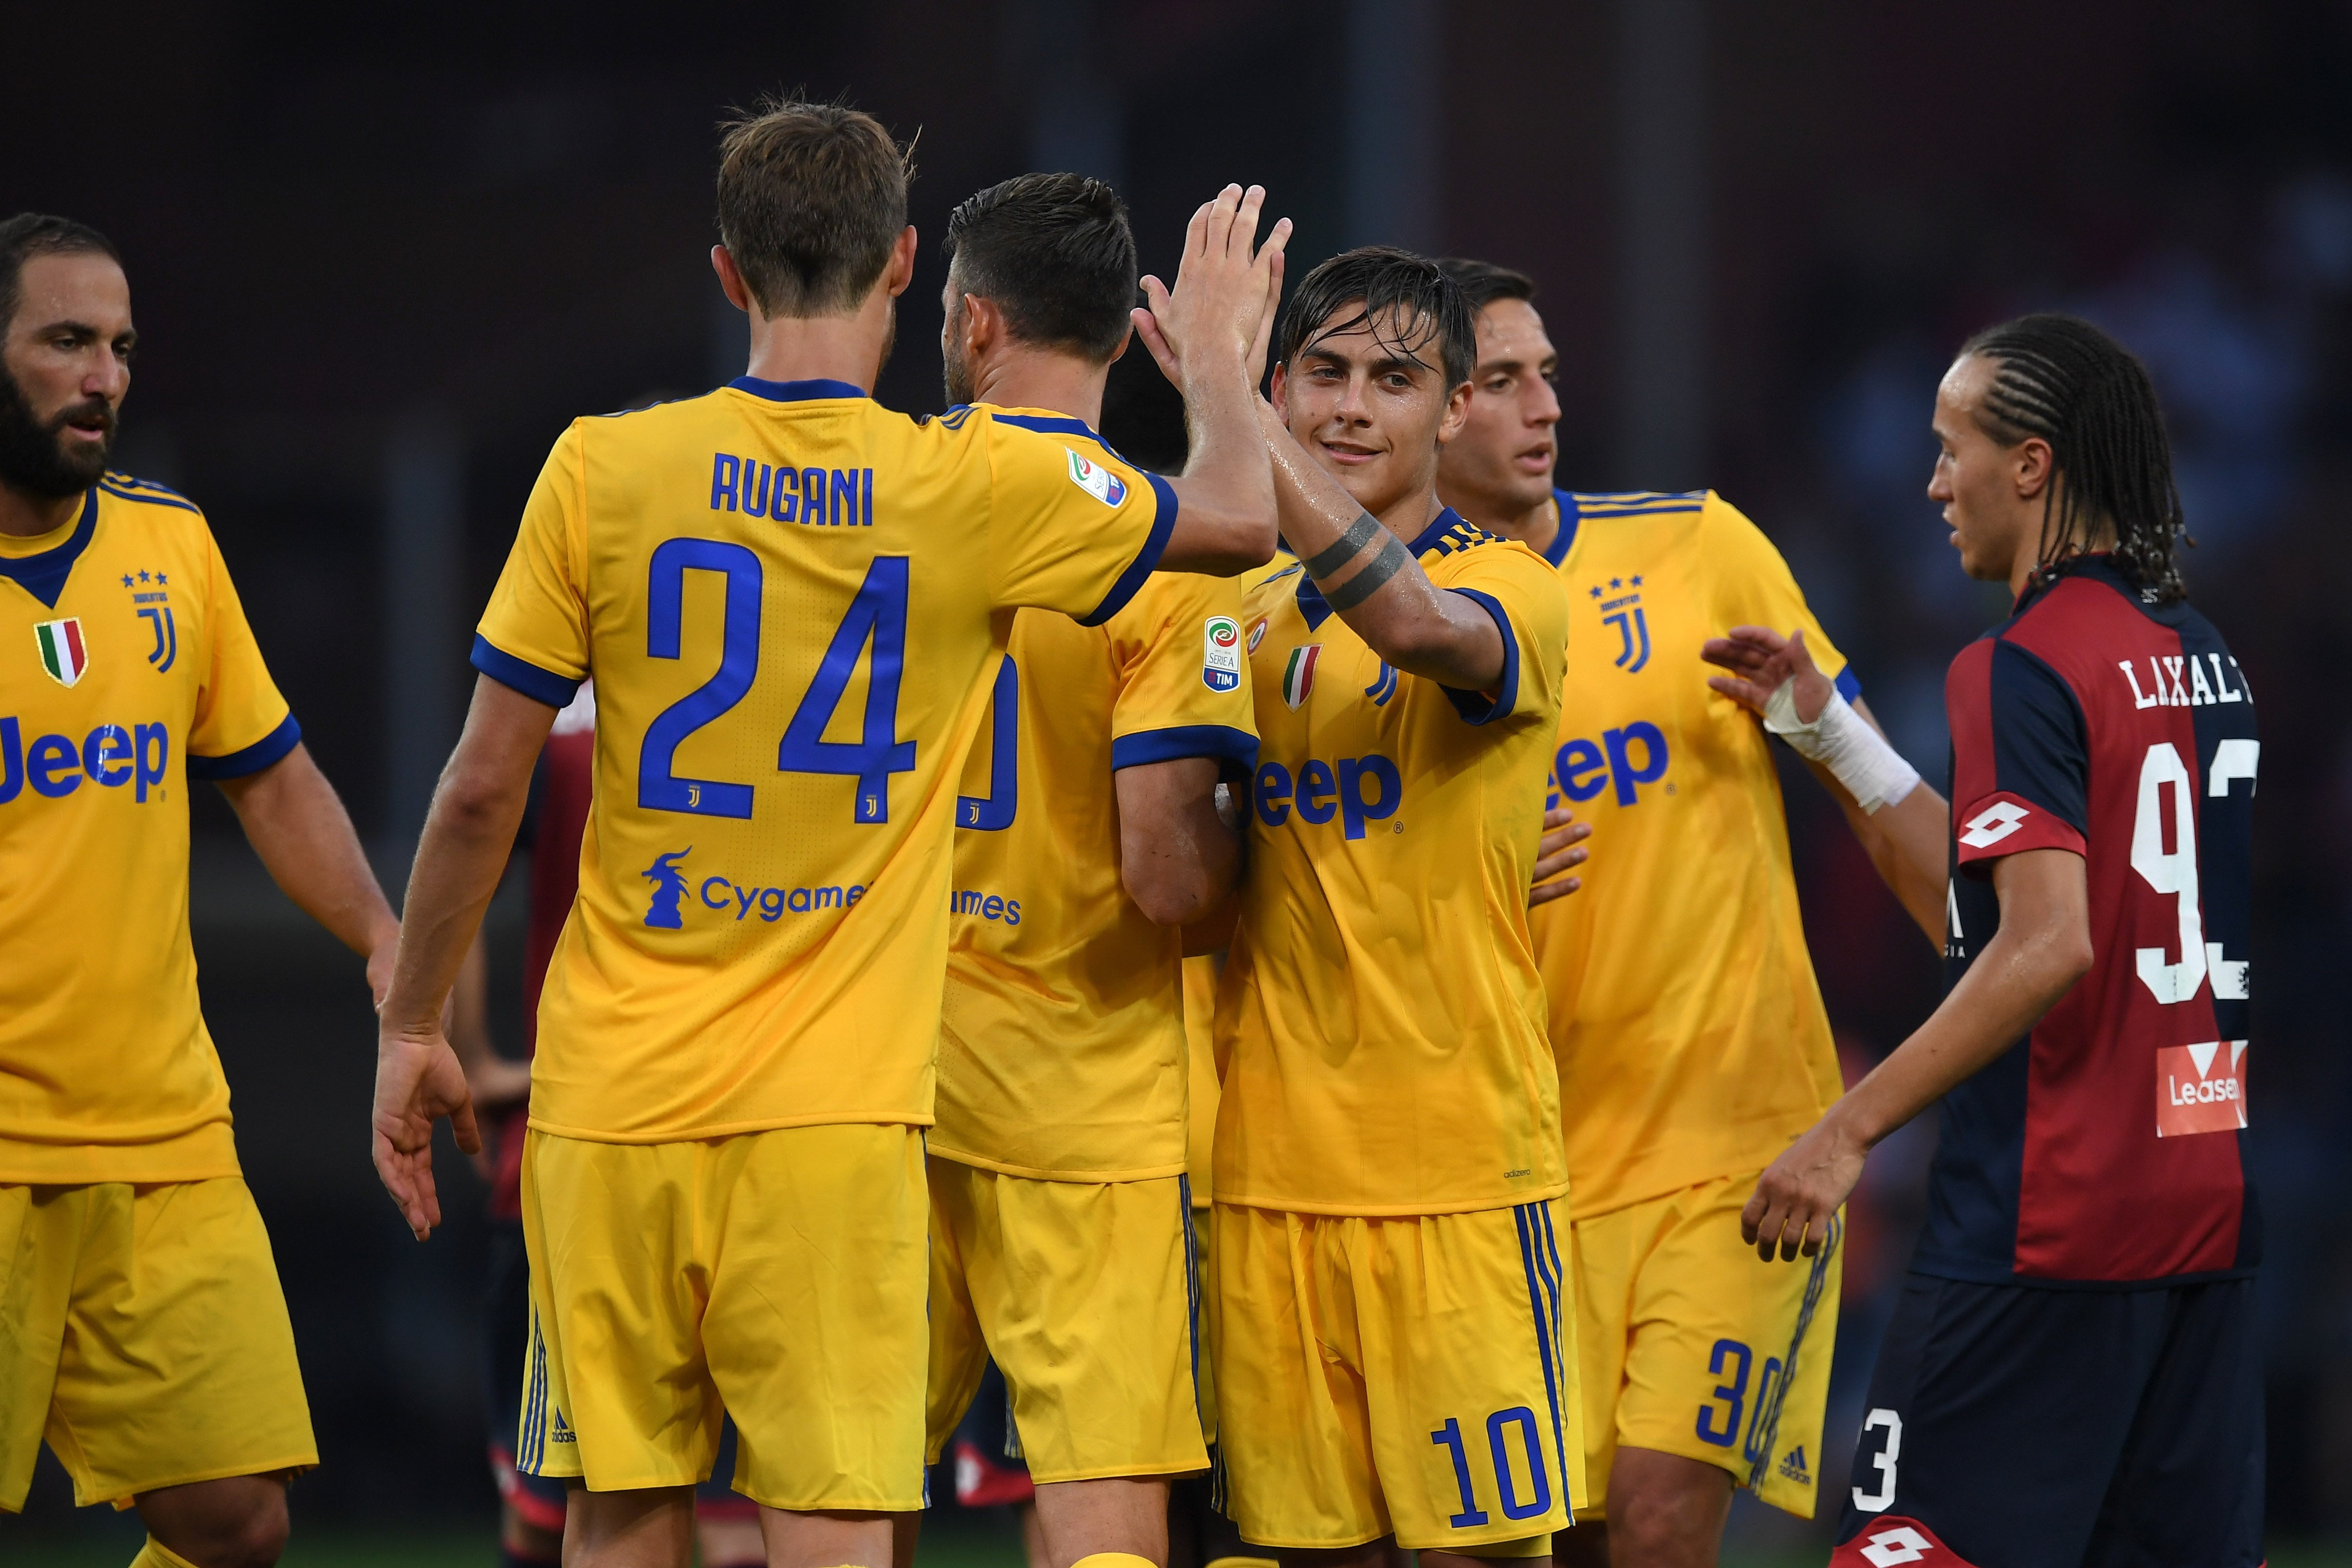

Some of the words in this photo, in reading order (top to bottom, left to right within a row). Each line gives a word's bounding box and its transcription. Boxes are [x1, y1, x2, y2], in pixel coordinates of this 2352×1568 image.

[710, 452, 873, 526] RUGANI
[637, 537, 917, 824] 24
[1209, 652, 1227, 666] SERIE
[1228, 657, 1234, 668] A
[1216, 673, 1233, 686] TIM
[2118, 652, 2254, 710] LAXAL
[0, 715, 169, 804] Jeep
[1545, 721, 1669, 807] ep
[700, 876, 874, 923] Cygame
[2169, 1074, 2241, 1106] Lease
[1504, 1169, 1531, 1179] adizero
[1696, 1338, 1782, 1464] 30
[1430, 1406, 1551, 1529] 10
[1851, 1407, 1904, 1513] 3
